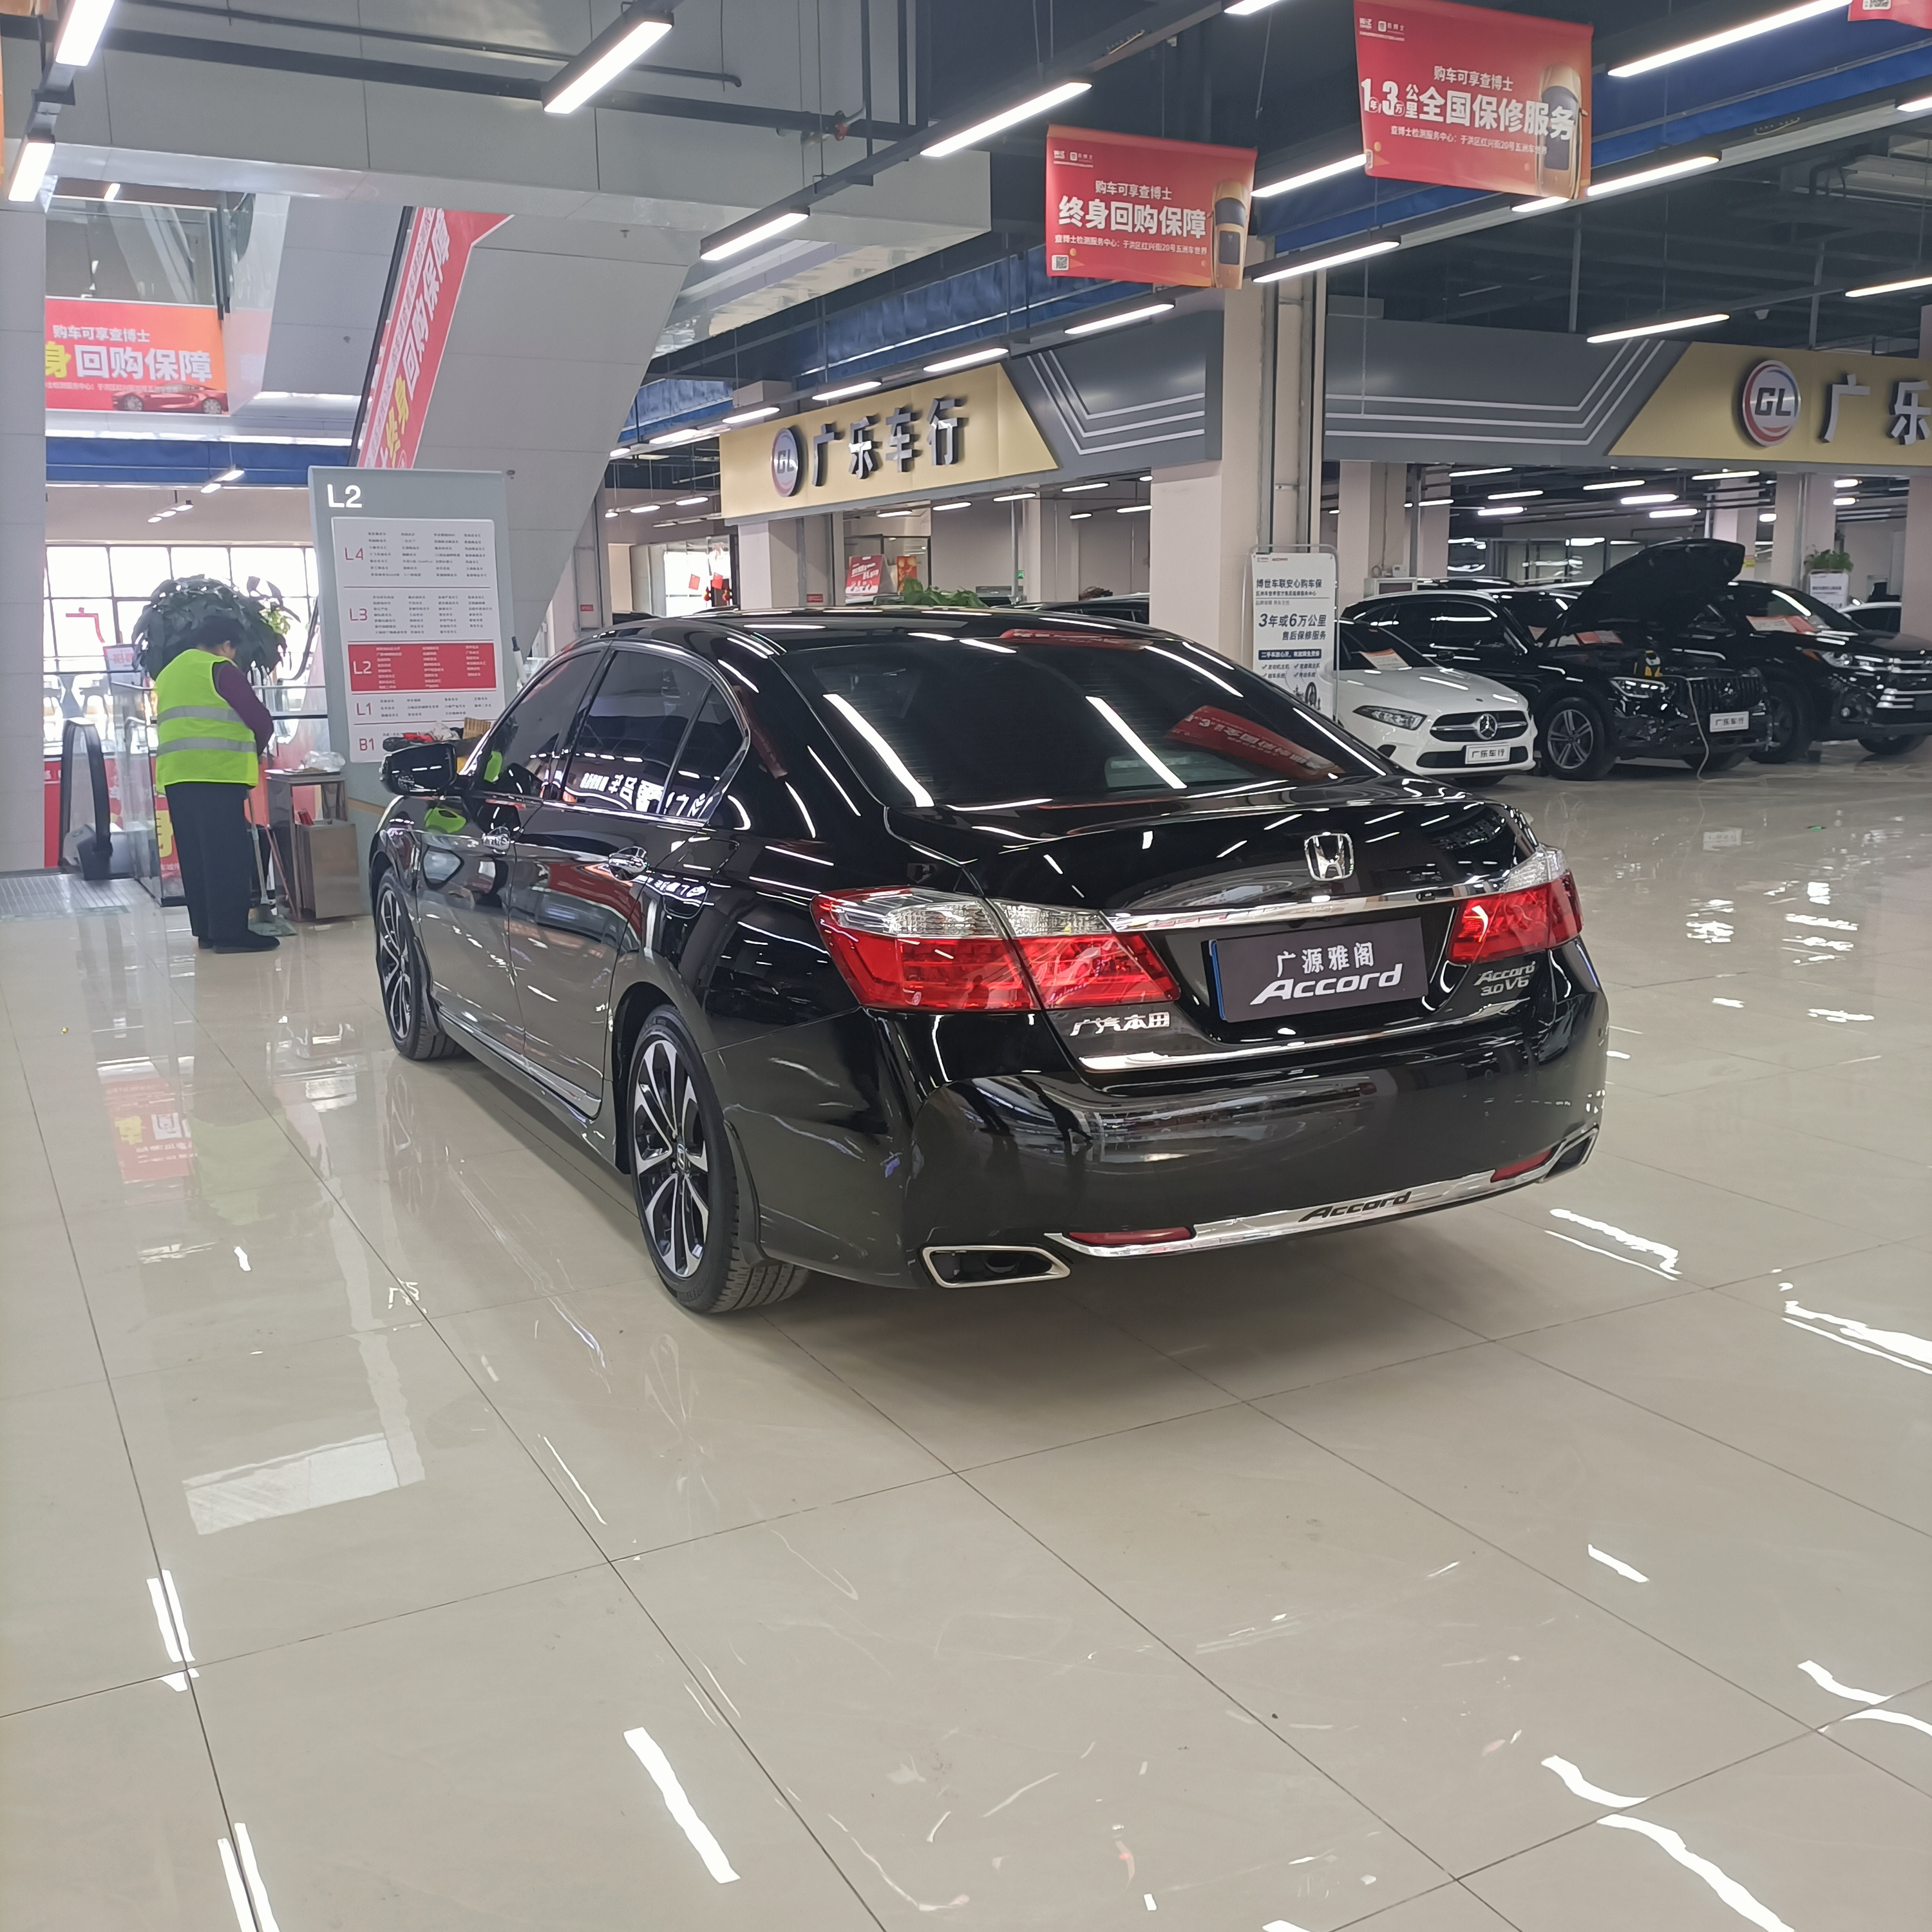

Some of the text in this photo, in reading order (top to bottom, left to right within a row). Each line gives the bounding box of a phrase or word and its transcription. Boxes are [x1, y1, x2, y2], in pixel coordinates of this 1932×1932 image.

[1434, 66, 1513, 92] 购车可享查博士
[1095, 180, 1172, 200] 购车可享查博士
[1059, 196, 1206, 238] 终身回购保障
[53, 325, 150, 343] 购车可享查博士
[1755, 387, 1791, 416] GL
[812, 397, 959, 487] 广乐车行
[777, 450, 795, 474] GL
[327, 484, 363, 508] L2
[345, 547, 365, 561] L4
[350, 608, 368, 621] L3
[1258, 613, 1327, 628] 3年或6万公里
[1282, 630, 1327, 641] 售后保修服务
[353, 661, 372, 674] L2
[357, 703, 372, 715] L1
[359, 738, 374, 751] B1
[1472, 749, 1505, 758] 广乐车行
[1277, 942, 1374, 978] 广源雅阁
[1249, 963, 1403, 1005] Accord
[1473, 961, 1536, 986] Accord
[1070, 1012, 1170, 1036] 广汽本田
[1298, 1191, 1412, 1223] Accord
